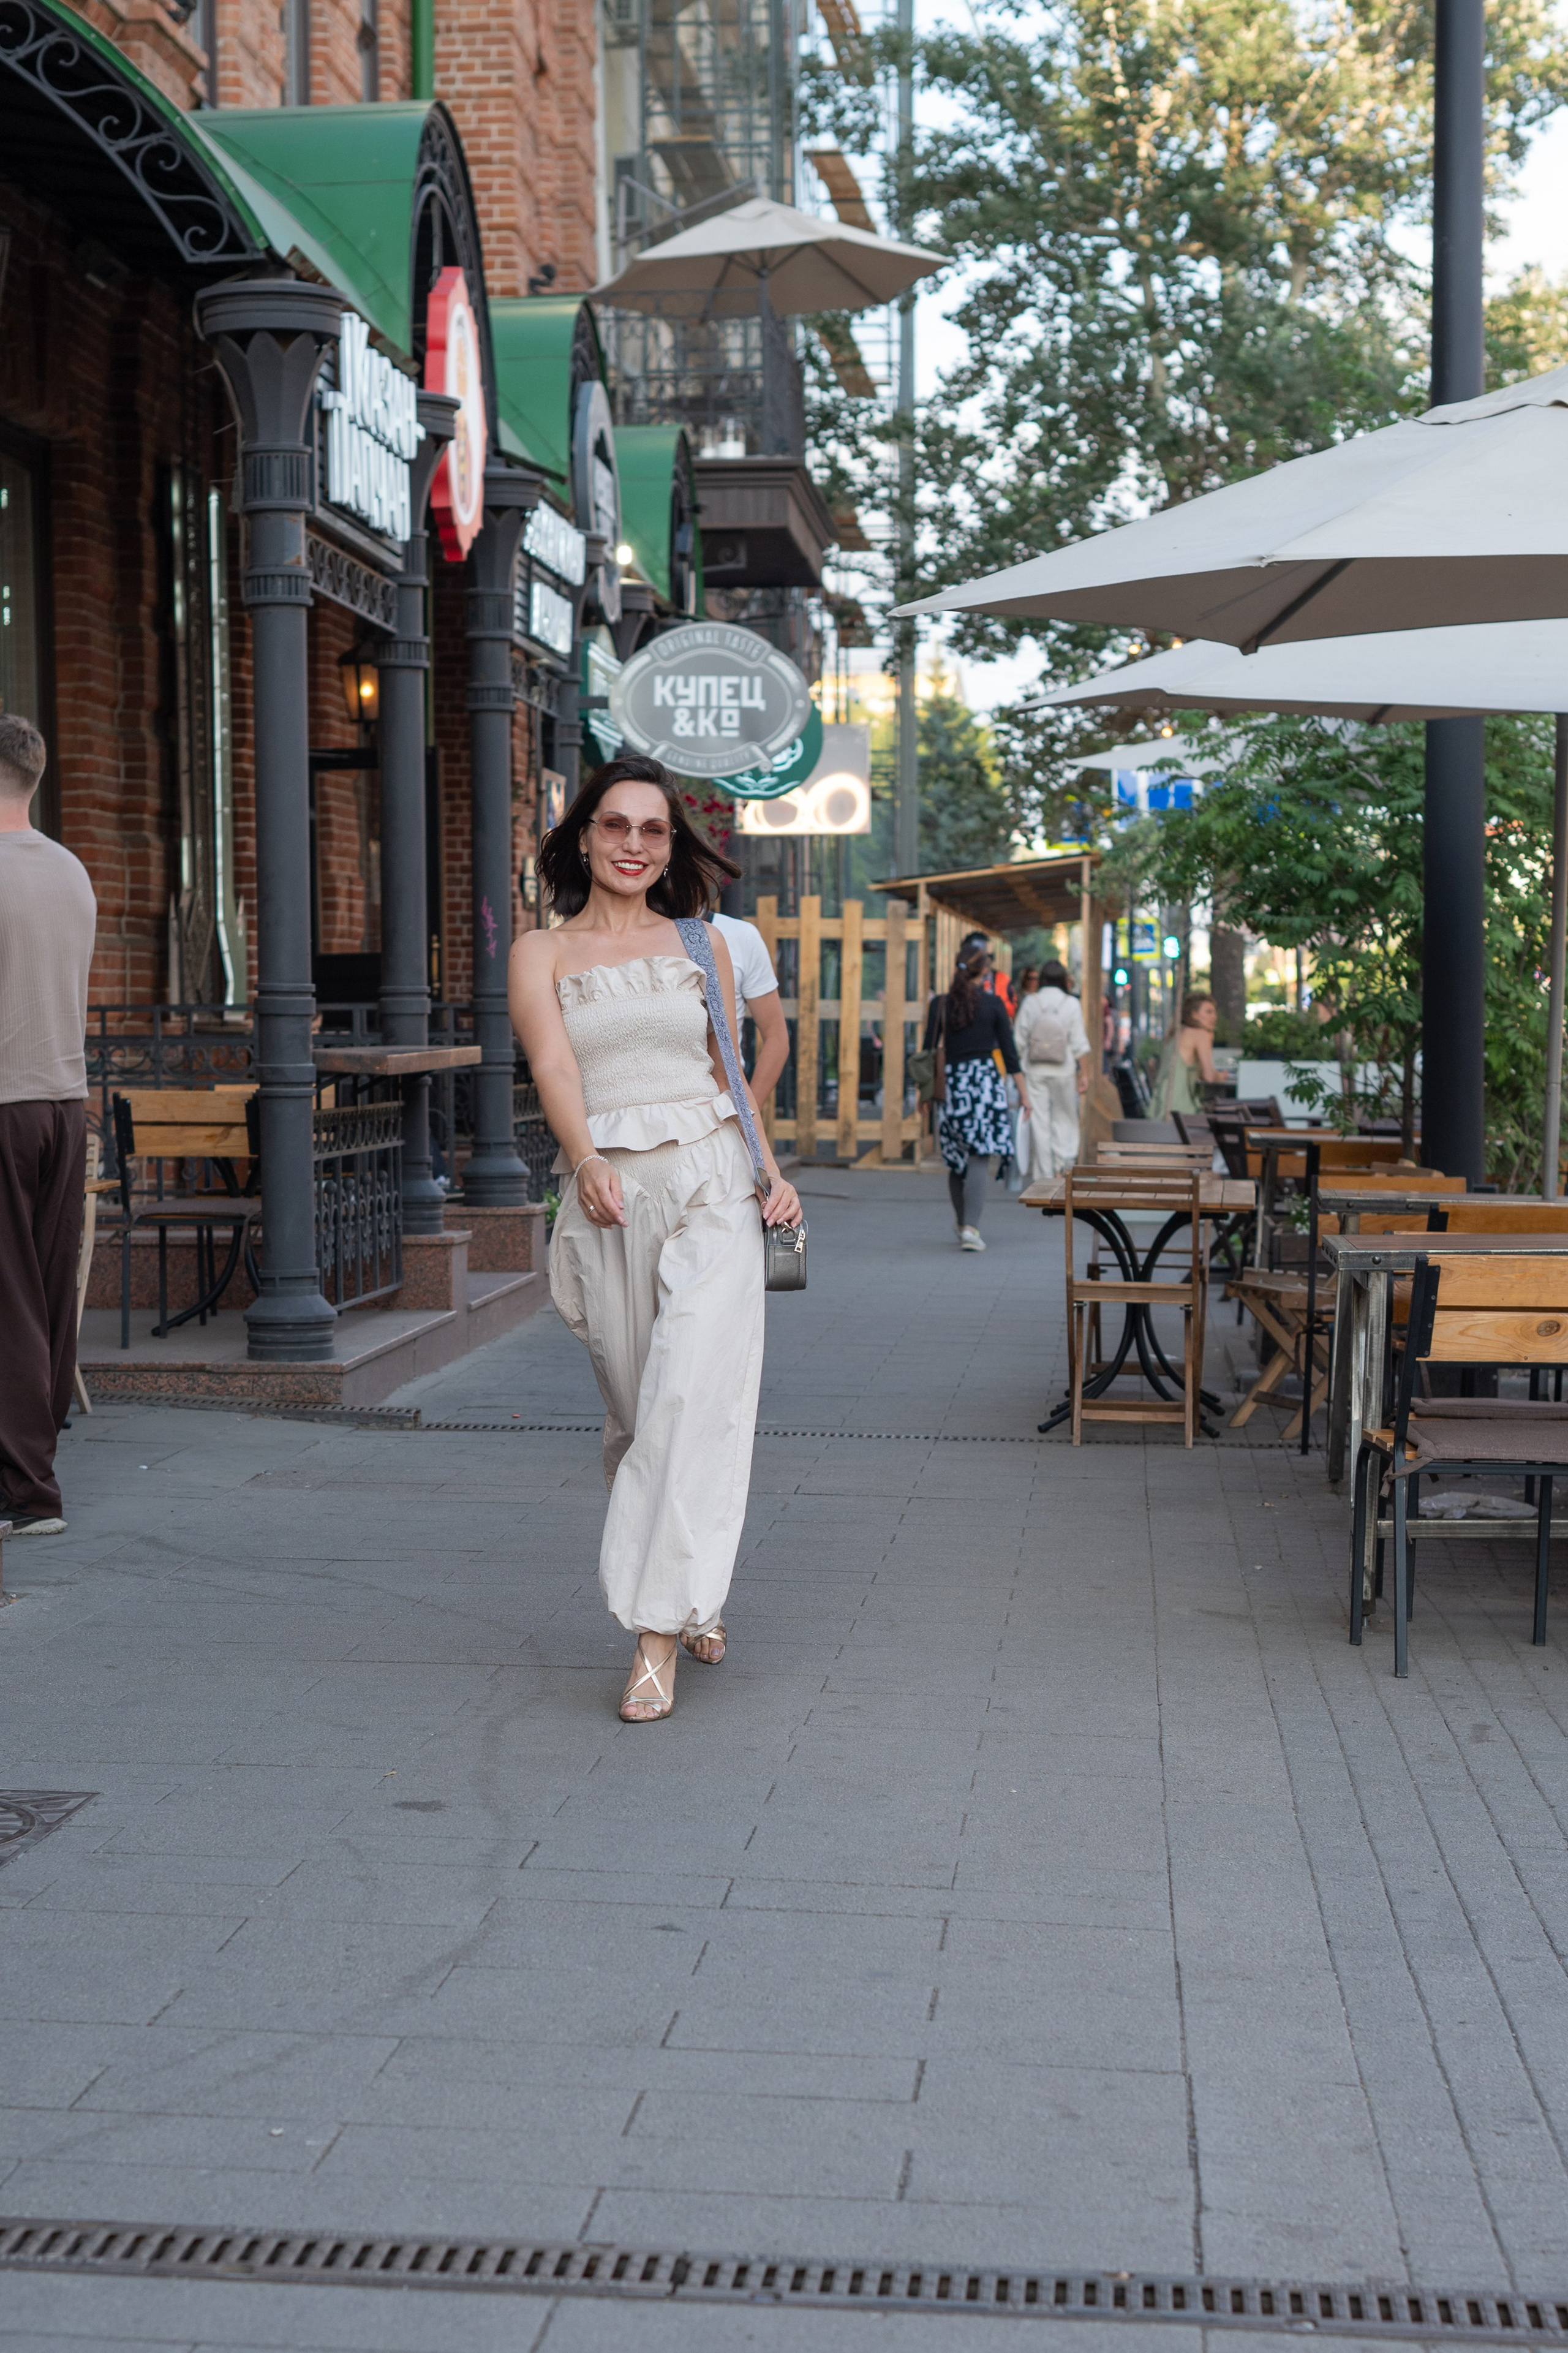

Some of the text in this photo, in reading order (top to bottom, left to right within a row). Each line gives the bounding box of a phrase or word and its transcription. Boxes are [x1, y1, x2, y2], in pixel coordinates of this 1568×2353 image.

[656, 629, 763, 660] ORIGINAL TASTE
[654, 675, 766, 711] КУПЕЦ
